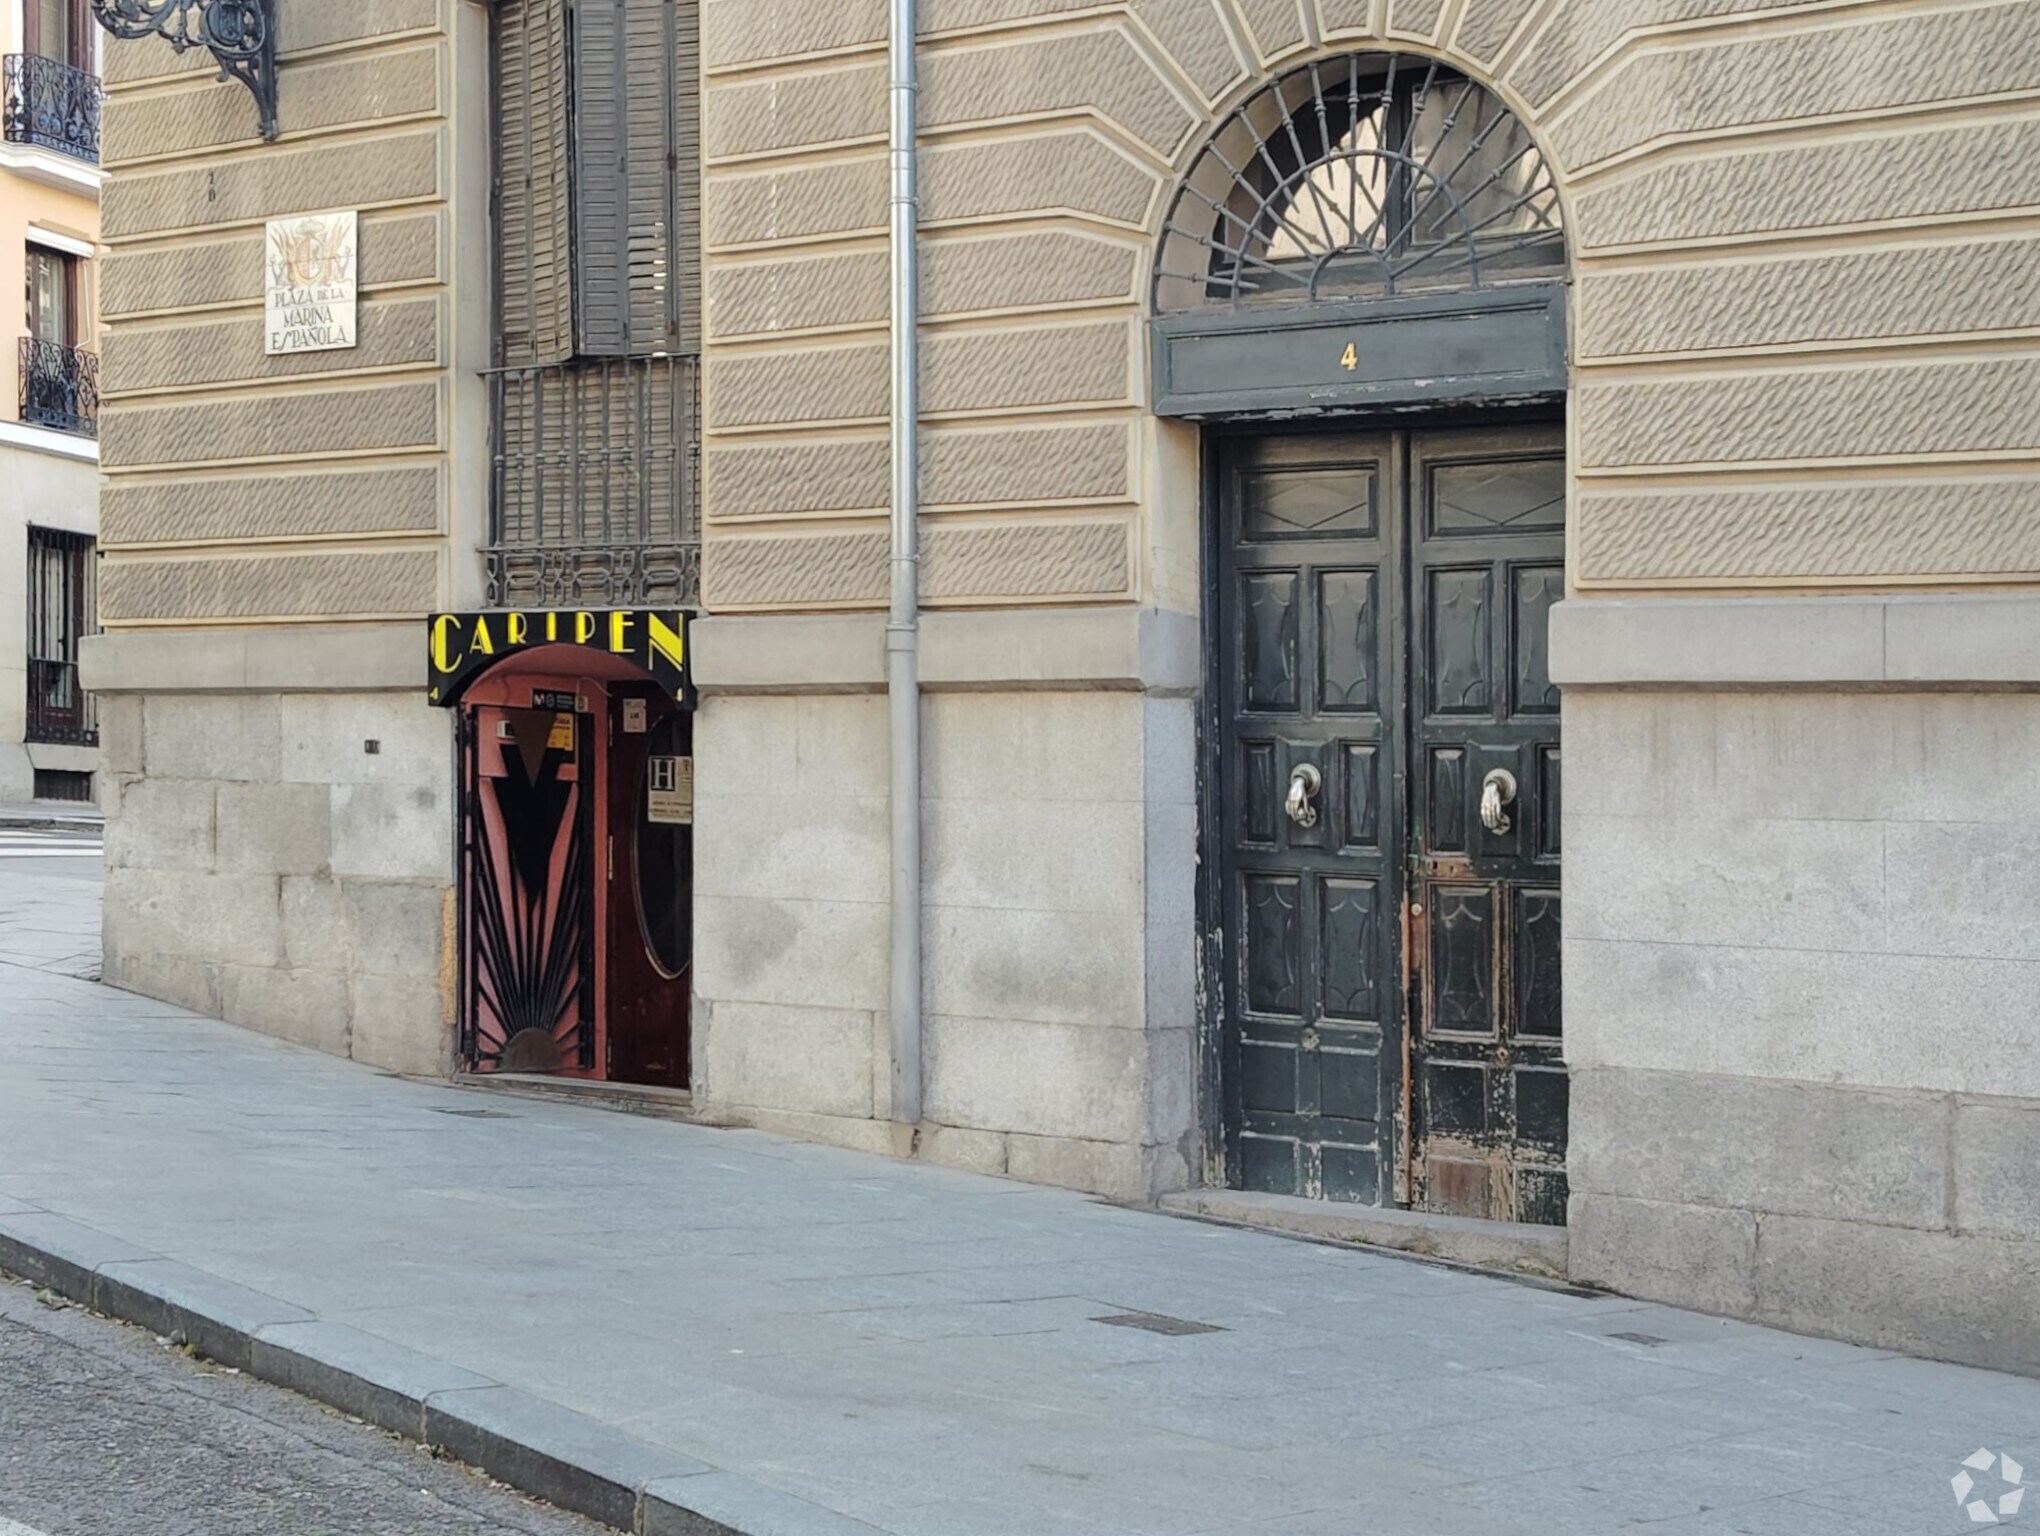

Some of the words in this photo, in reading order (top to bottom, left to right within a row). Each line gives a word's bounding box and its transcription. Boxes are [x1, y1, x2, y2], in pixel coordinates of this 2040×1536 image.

[275, 289, 313, 307] PLAZA
[317, 290, 328, 300] DE
[331, 288, 344, 299] LA
[283, 306, 333, 327] MARINA
[271, 325, 348, 350] ESPAÑOLA
[1340, 342, 1358, 371] 4
[430, 611, 684, 673] CARIPEN
[652, 759, 674, 789] H
